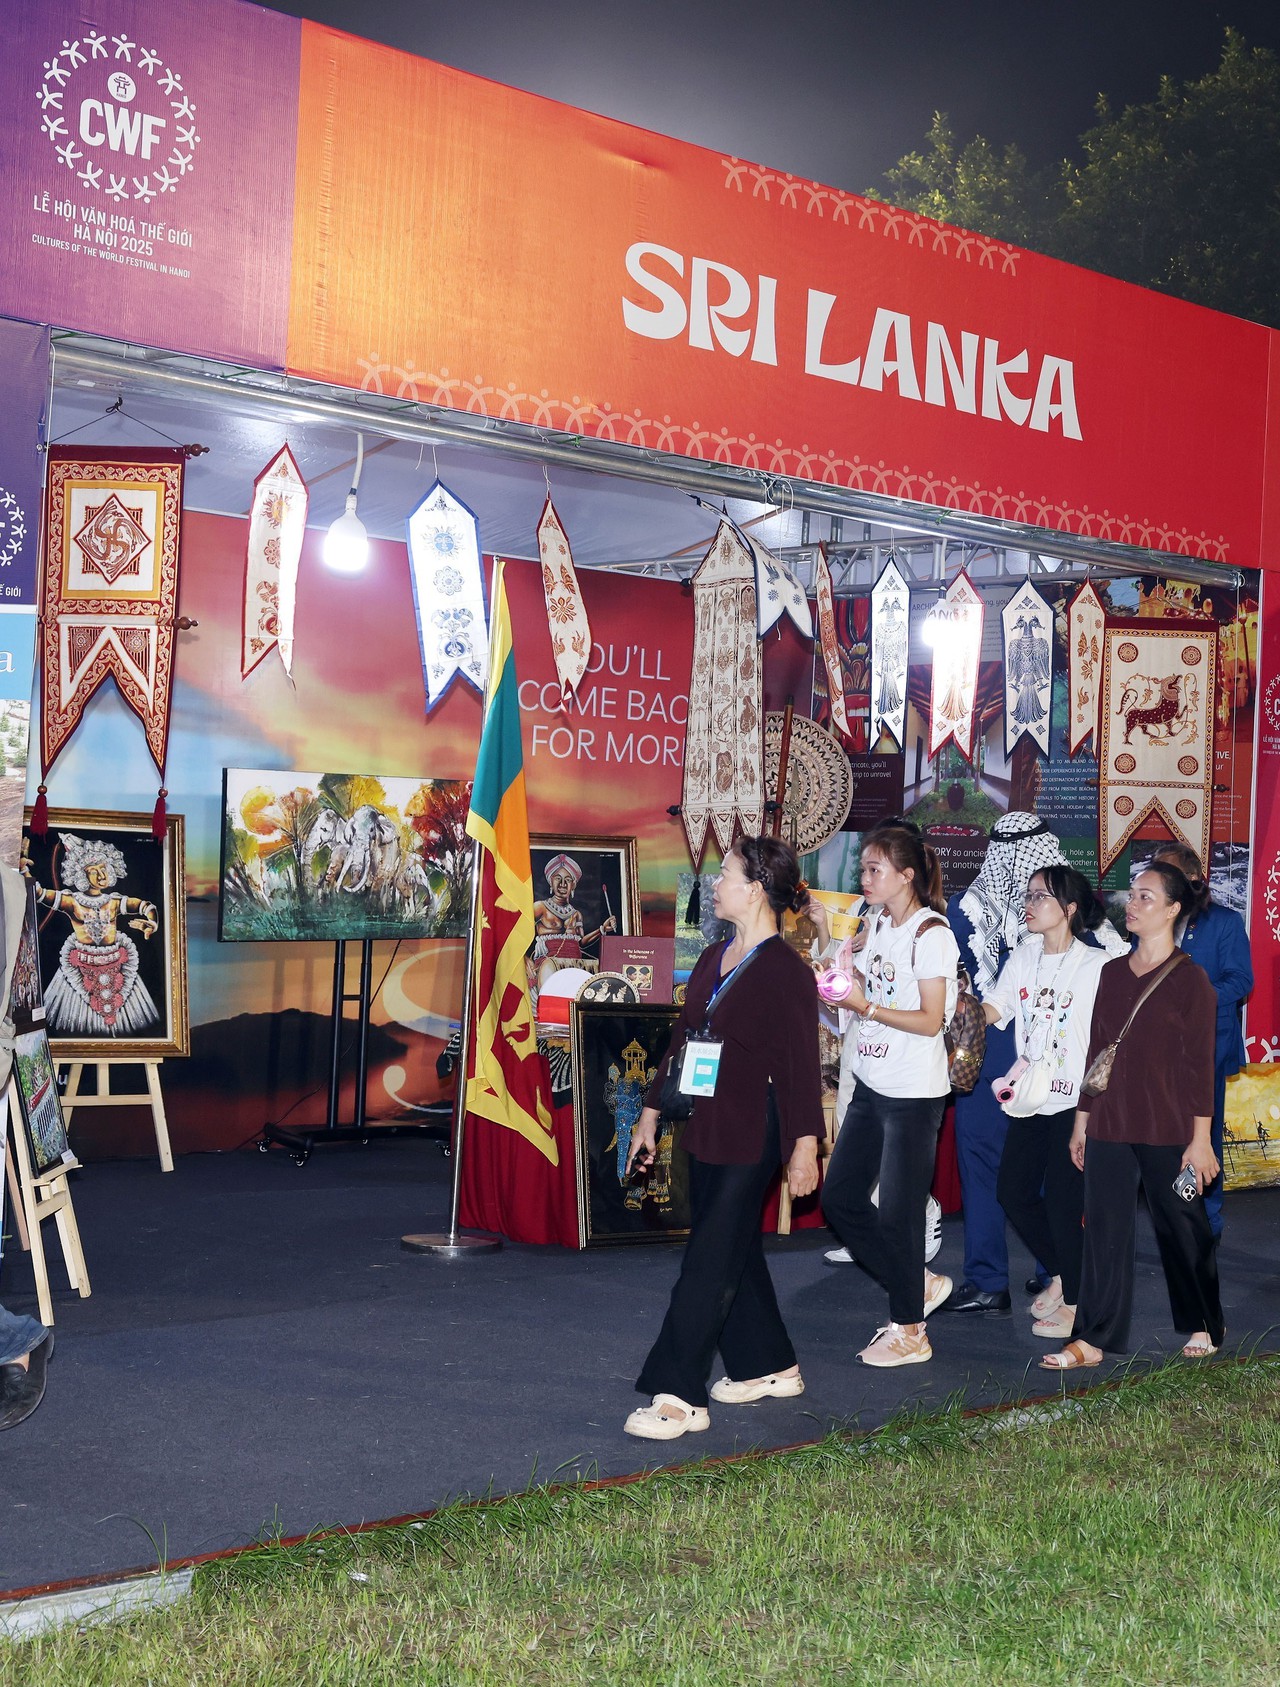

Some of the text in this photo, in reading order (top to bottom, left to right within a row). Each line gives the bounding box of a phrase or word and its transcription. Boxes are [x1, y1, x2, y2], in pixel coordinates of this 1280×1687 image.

[79, 98, 166, 160] CWF
[33, 191, 192, 247] LỄ HỘI VĂN HOÁ THẾ GIỚI
[73, 222, 153, 256] HÀ NỘI 2025
[31, 234, 191, 279] CULTURES OF THE WORLD FESTIVAL IN HANOI
[622, 241, 1084, 441] SRI LANKA
[5, 587, 21, 597] GIỚI
[585, 642, 671, 681] OU'LL
[517, 679, 688, 725] COME BAC
[531, 725, 687, 766] FOR MOR
[934, 847, 952, 856] ORY
